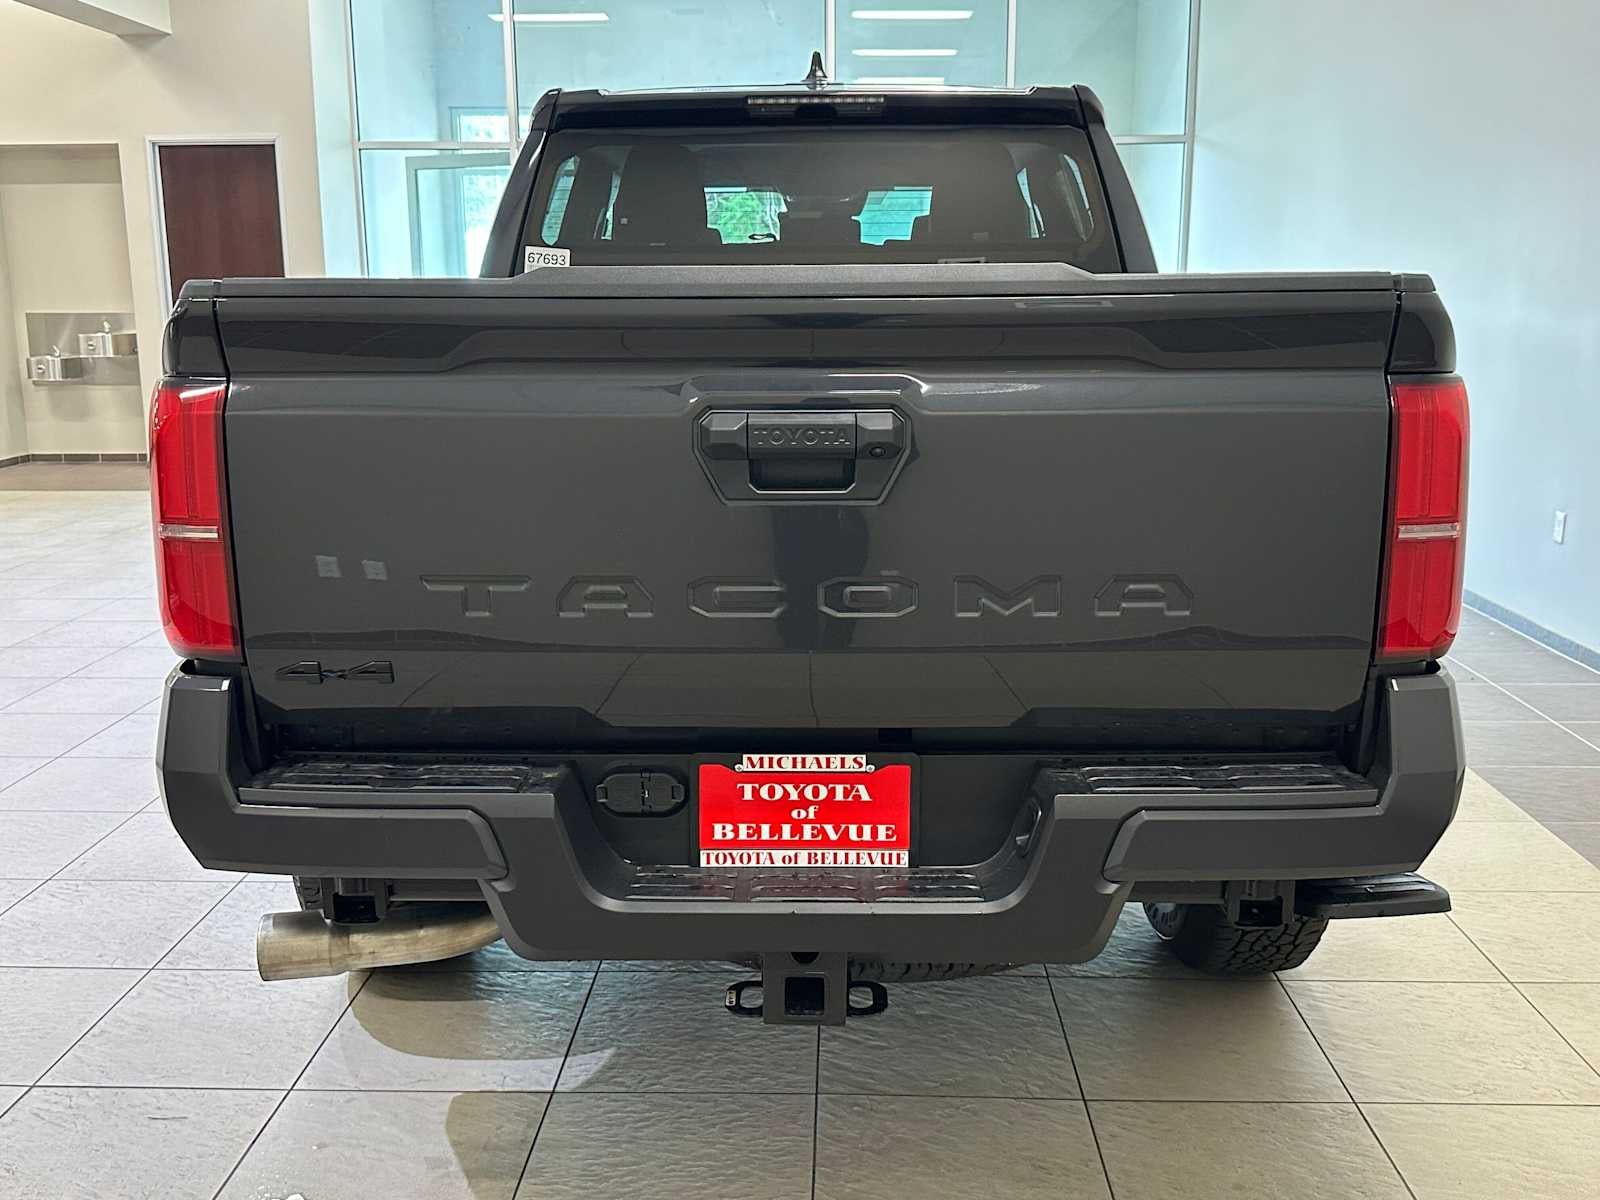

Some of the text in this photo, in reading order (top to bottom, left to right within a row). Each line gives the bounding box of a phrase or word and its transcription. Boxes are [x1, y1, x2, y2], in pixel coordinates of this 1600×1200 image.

[527, 252, 566, 266] 67693
[753, 428, 851, 446] TOYOTA
[419, 574, 1194, 619] TACOMA
[745, 756, 864, 770] MICHAELS
[736, 783, 873, 802] TOYOTA
[790, 804, 820, 820] of
[711, 822, 897, 842] BELLEVUE
[702, 851, 907, 866] TOYOTA of BELLEVUE
